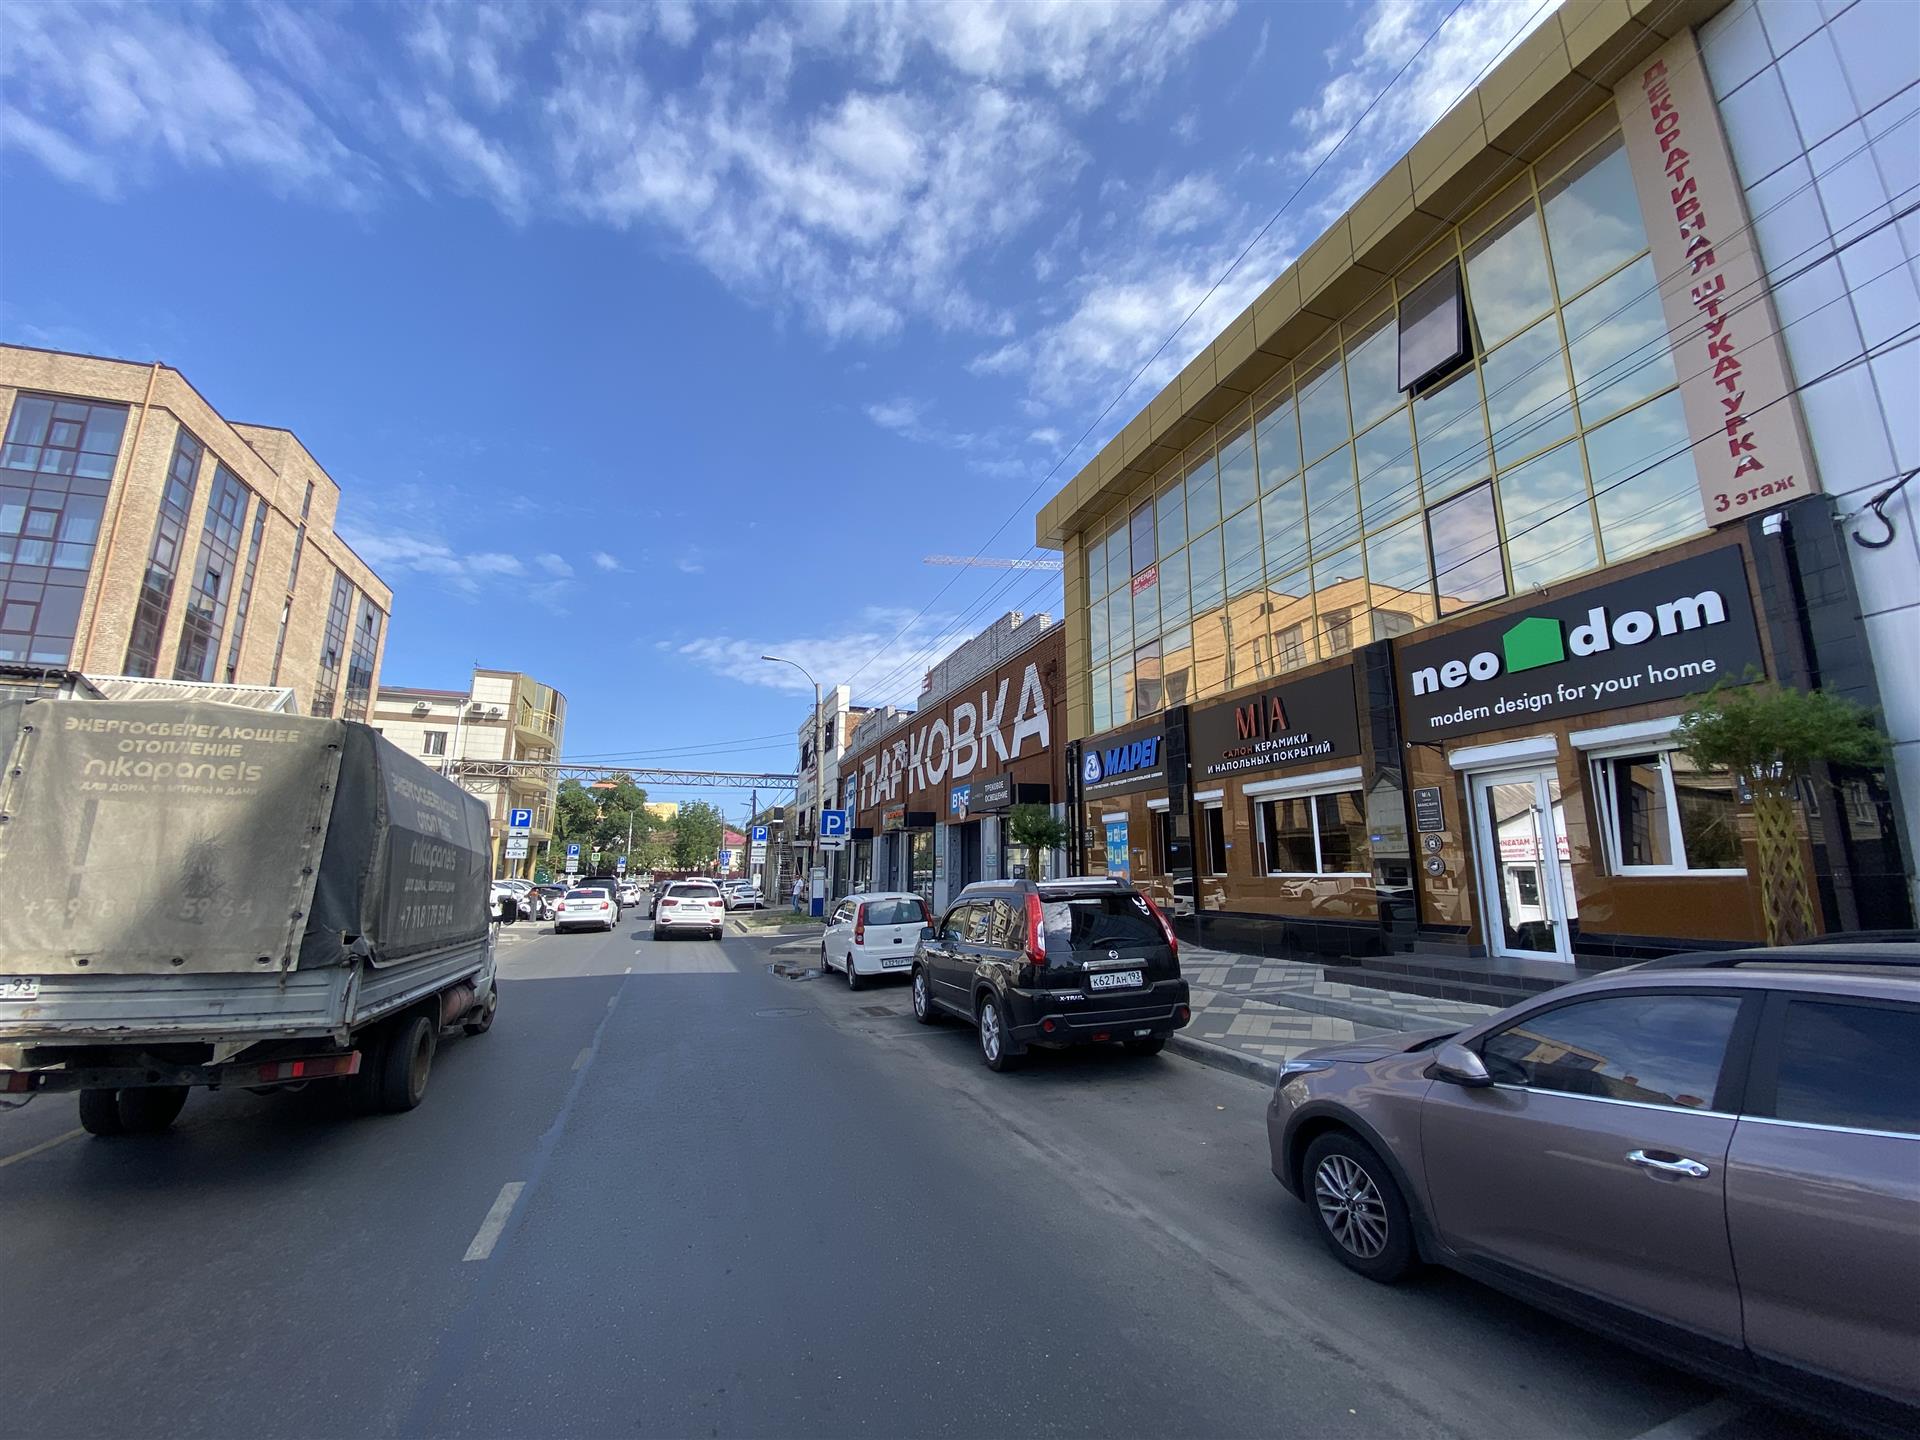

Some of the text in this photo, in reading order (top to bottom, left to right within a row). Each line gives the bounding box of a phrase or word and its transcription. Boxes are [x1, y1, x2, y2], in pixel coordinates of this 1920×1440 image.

[1643, 58, 1716, 276] ДЕКОРАТИВНАЯ
[1692, 274, 1765, 479] ШТУКАТУРКА
[1714, 475, 1795, 512] 3 этаж
[1412, 590, 1726, 696] neo dom
[1430, 658, 1718, 728] modern design for your home
[64, 716, 300, 743] ЭНЕРГОСБЕРЕГАЮЩЕЕ
[861, 662, 1050, 810] ПАРКОВКА
[118, 739, 243, 757] ОТОПЛЕНИЕ
[1104, 736, 1157, 777] MAPEI
[1207, 740, 1332, 774] И НАПОЛЬНЫХ ПОКРЫТИЙ
[1223, 733, 1309, 760] САЛОН КЕРАМИКИ
[84, 756, 264, 782] nikapanels
[515, 811, 528, 826] P
[827, 815, 841, 836] P
[756, 827, 765, 839] P
[570, 845, 578, 854] P
[14, 978, 32, 992] 93
[1127, 971, 1140, 980] 193
